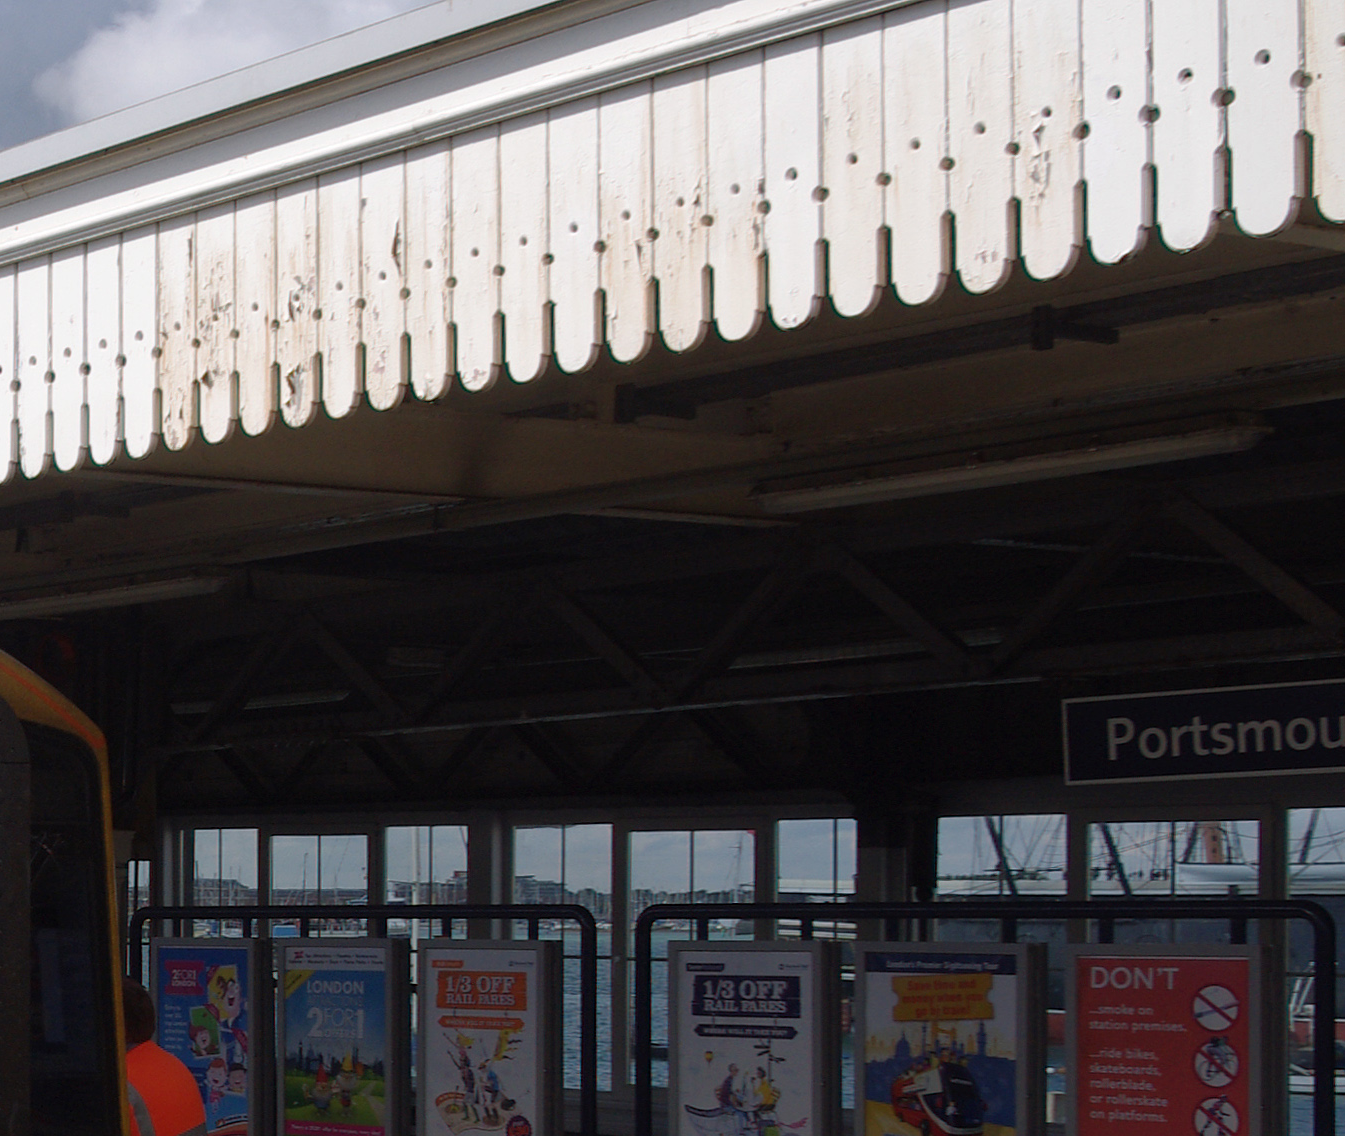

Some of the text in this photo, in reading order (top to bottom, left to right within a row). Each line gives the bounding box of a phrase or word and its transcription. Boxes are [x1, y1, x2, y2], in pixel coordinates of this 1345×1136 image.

[1106, 715, 1345, 761] Portsmou
[446, 974, 515, 994] 1/3 OFF
[1090, 966, 1180, 990] DON'T
[306, 980, 364, 995] LONDON
[702, 979, 789, 1000] 1/3 OFF
[446, 993, 516, 1006] RAIL FARES
[703, 1000, 788, 1014] RAIL FARES
[1138, 1007, 1154, 1015] on
[1089, 1019, 1129, 1030] station
[1090, 1094, 1169, 1107] or rollerskate
[1090, 1110, 1105, 1119] on
